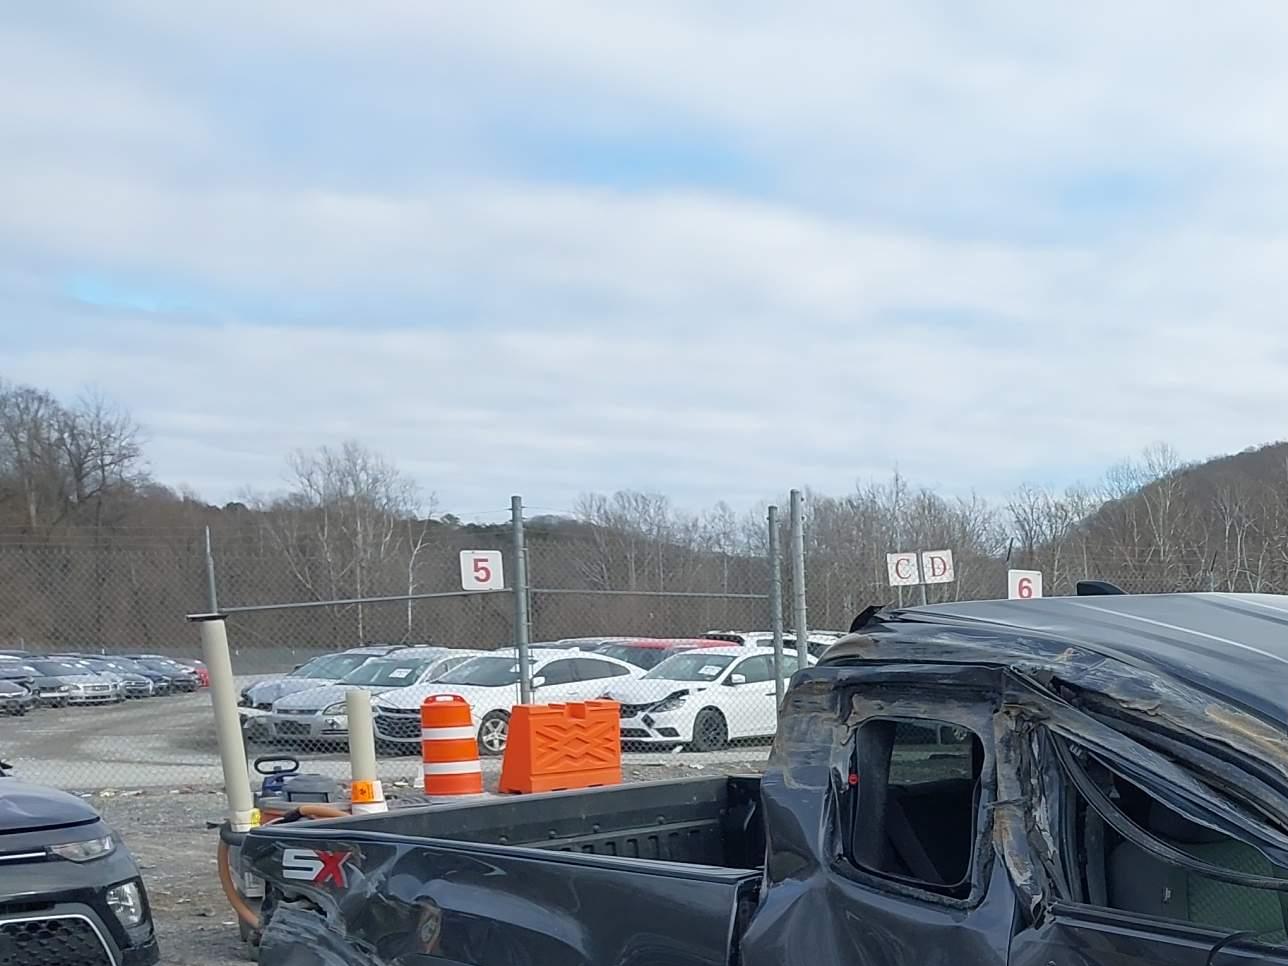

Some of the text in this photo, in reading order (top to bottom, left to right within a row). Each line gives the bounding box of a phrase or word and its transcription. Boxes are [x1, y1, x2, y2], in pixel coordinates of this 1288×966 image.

[473, 558, 492, 583] 5
[895, 558, 912, 580] C
[929, 555, 947, 577] D
[1018, 577, 1033, 599] 6
